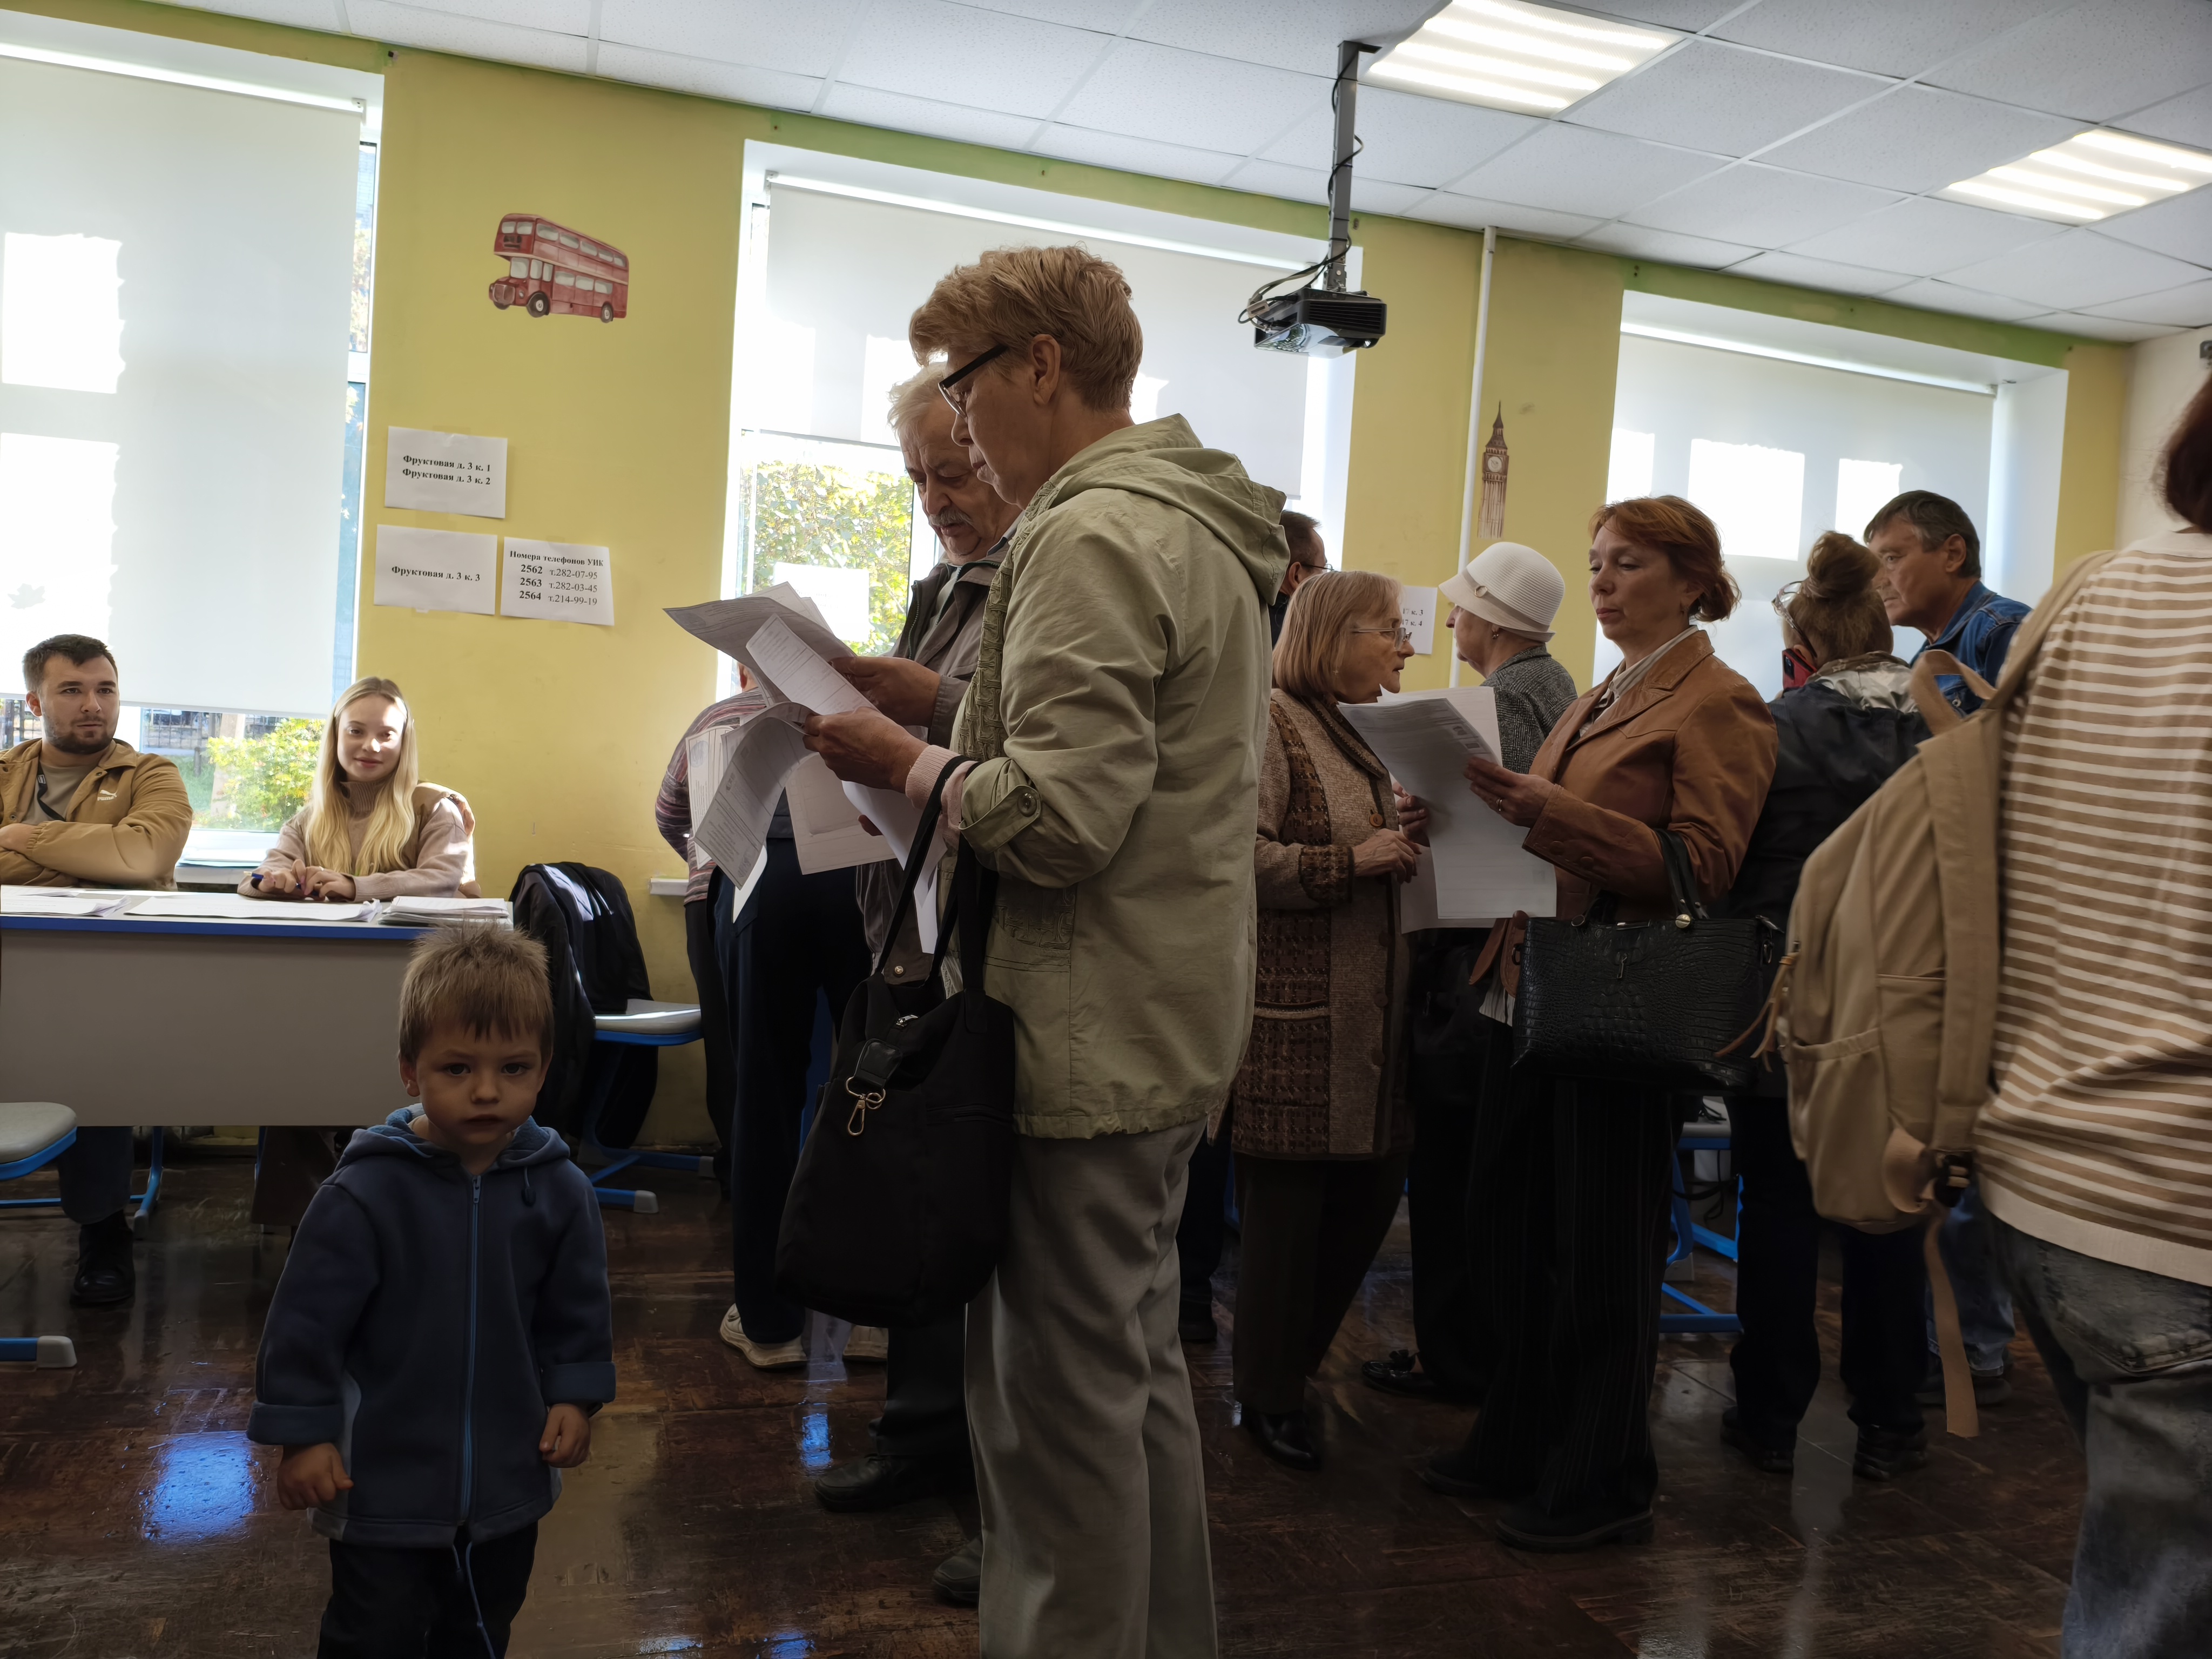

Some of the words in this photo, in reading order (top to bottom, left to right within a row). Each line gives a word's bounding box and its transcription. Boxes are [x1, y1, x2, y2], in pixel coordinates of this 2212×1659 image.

[403, 455, 454, 468] Фруктовая
[467, 462, 473, 470] 3
[487, 464, 490, 472] 1
[402, 468, 454, 481] Фруктовая
[467, 475, 472, 483] 3
[510, 550, 541, 561] Номера
[543, 555, 585, 565] телефонов
[588, 558, 604, 567] УИК
[392, 566, 443, 578] Фруктовая
[475, 574, 480, 582] 3
[521, 564, 543, 574] 2562
[549, 568, 598, 579] т.282-07-95
[520, 577, 542, 588] 2563
[549, 582, 598, 593] т.282-03-45
[519, 590, 542, 601] 2564
[548, 595, 598, 606] т.214-99-19
